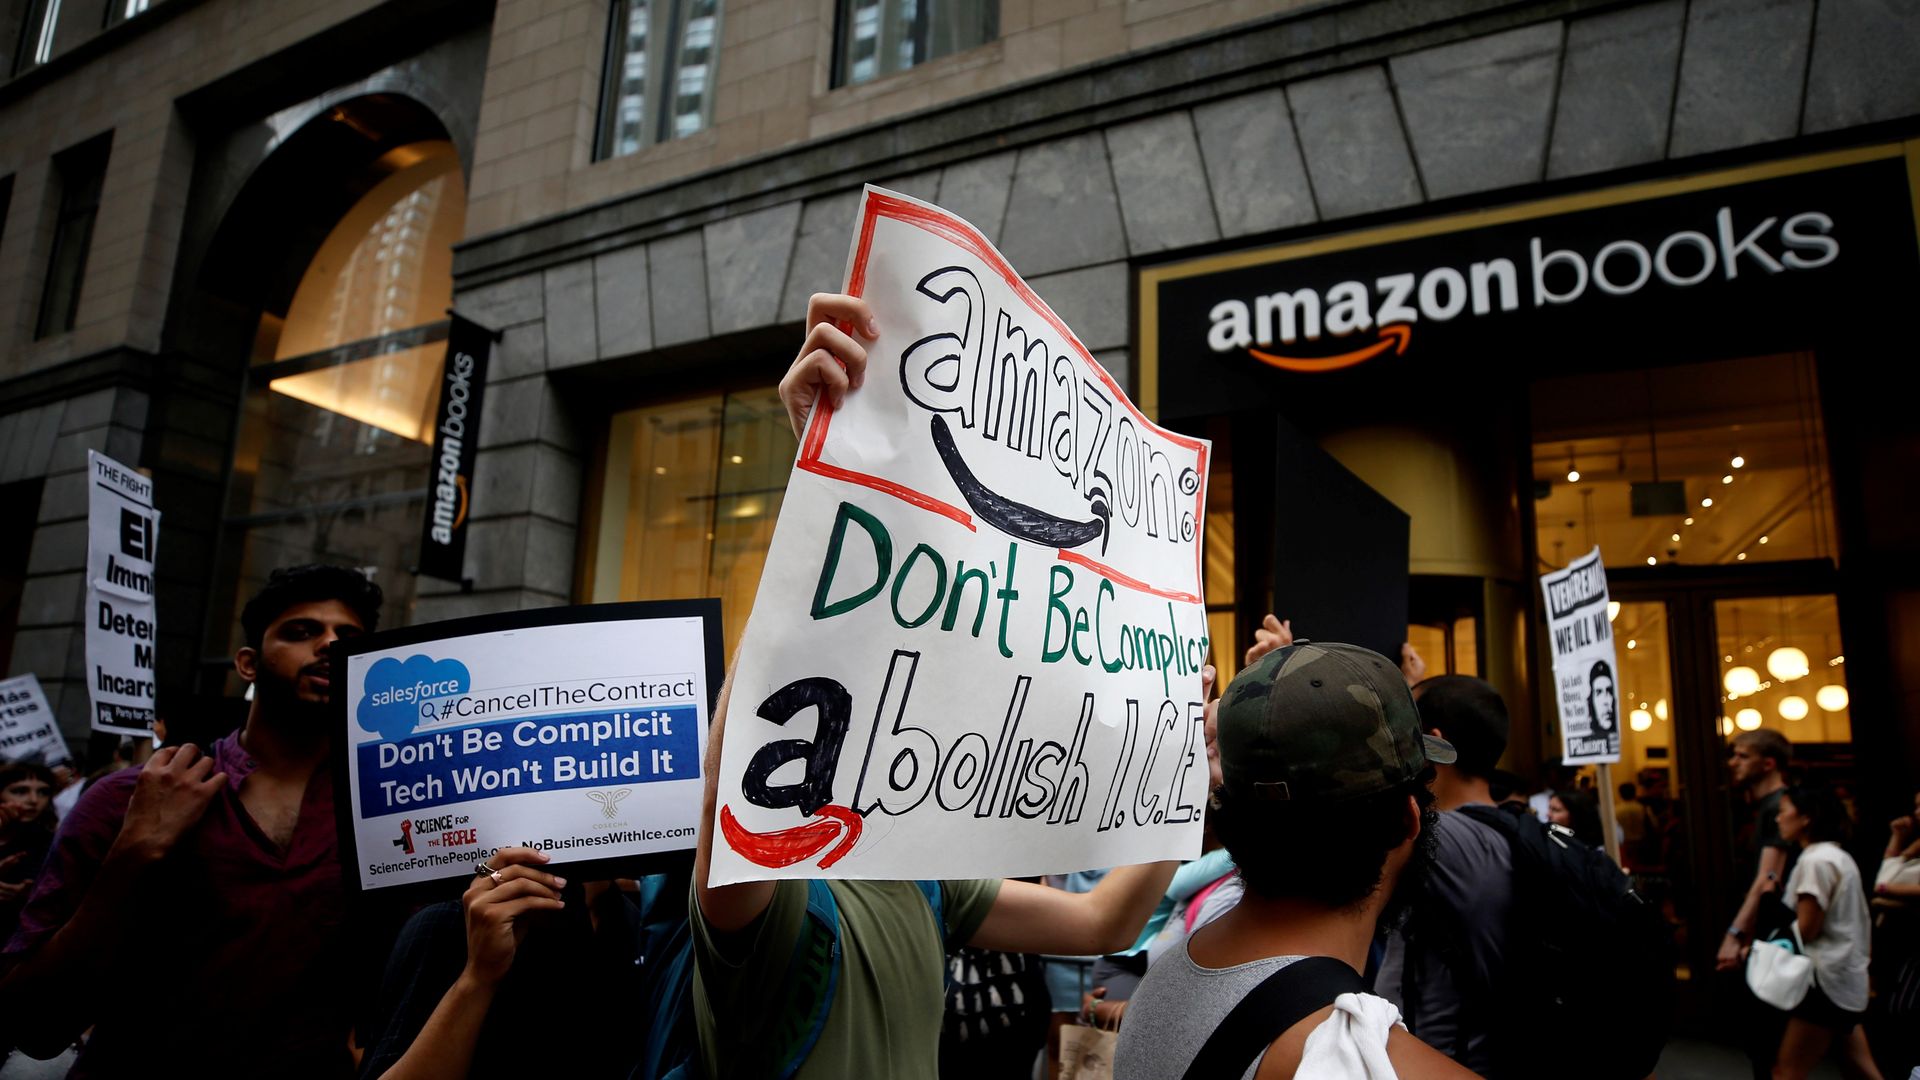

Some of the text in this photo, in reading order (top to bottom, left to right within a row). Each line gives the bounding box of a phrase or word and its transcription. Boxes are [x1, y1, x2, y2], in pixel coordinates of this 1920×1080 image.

[97, 461, 150, 497] THE FIGHT
[810, 502, 1019, 658] Don't
[1042, 565, 1092, 666] Be
[372, 679, 459, 707] salesforce
[441, 679, 695, 720] #CancelTheContract
[379, 711, 673, 769] Don't Be Complicit
[741, 649, 1202, 832] abolish I.C.E.
[380, 748, 673, 807] Tech Won't Build It
[415, 814, 470, 835] SCIENCE FOR
[427, 828, 477, 848] THE PEOPLE
[592, 821, 628, 830] COSECHA
[369, 827, 695, 876] ScienceForThePeople.o NoBusinessWithIce.com
